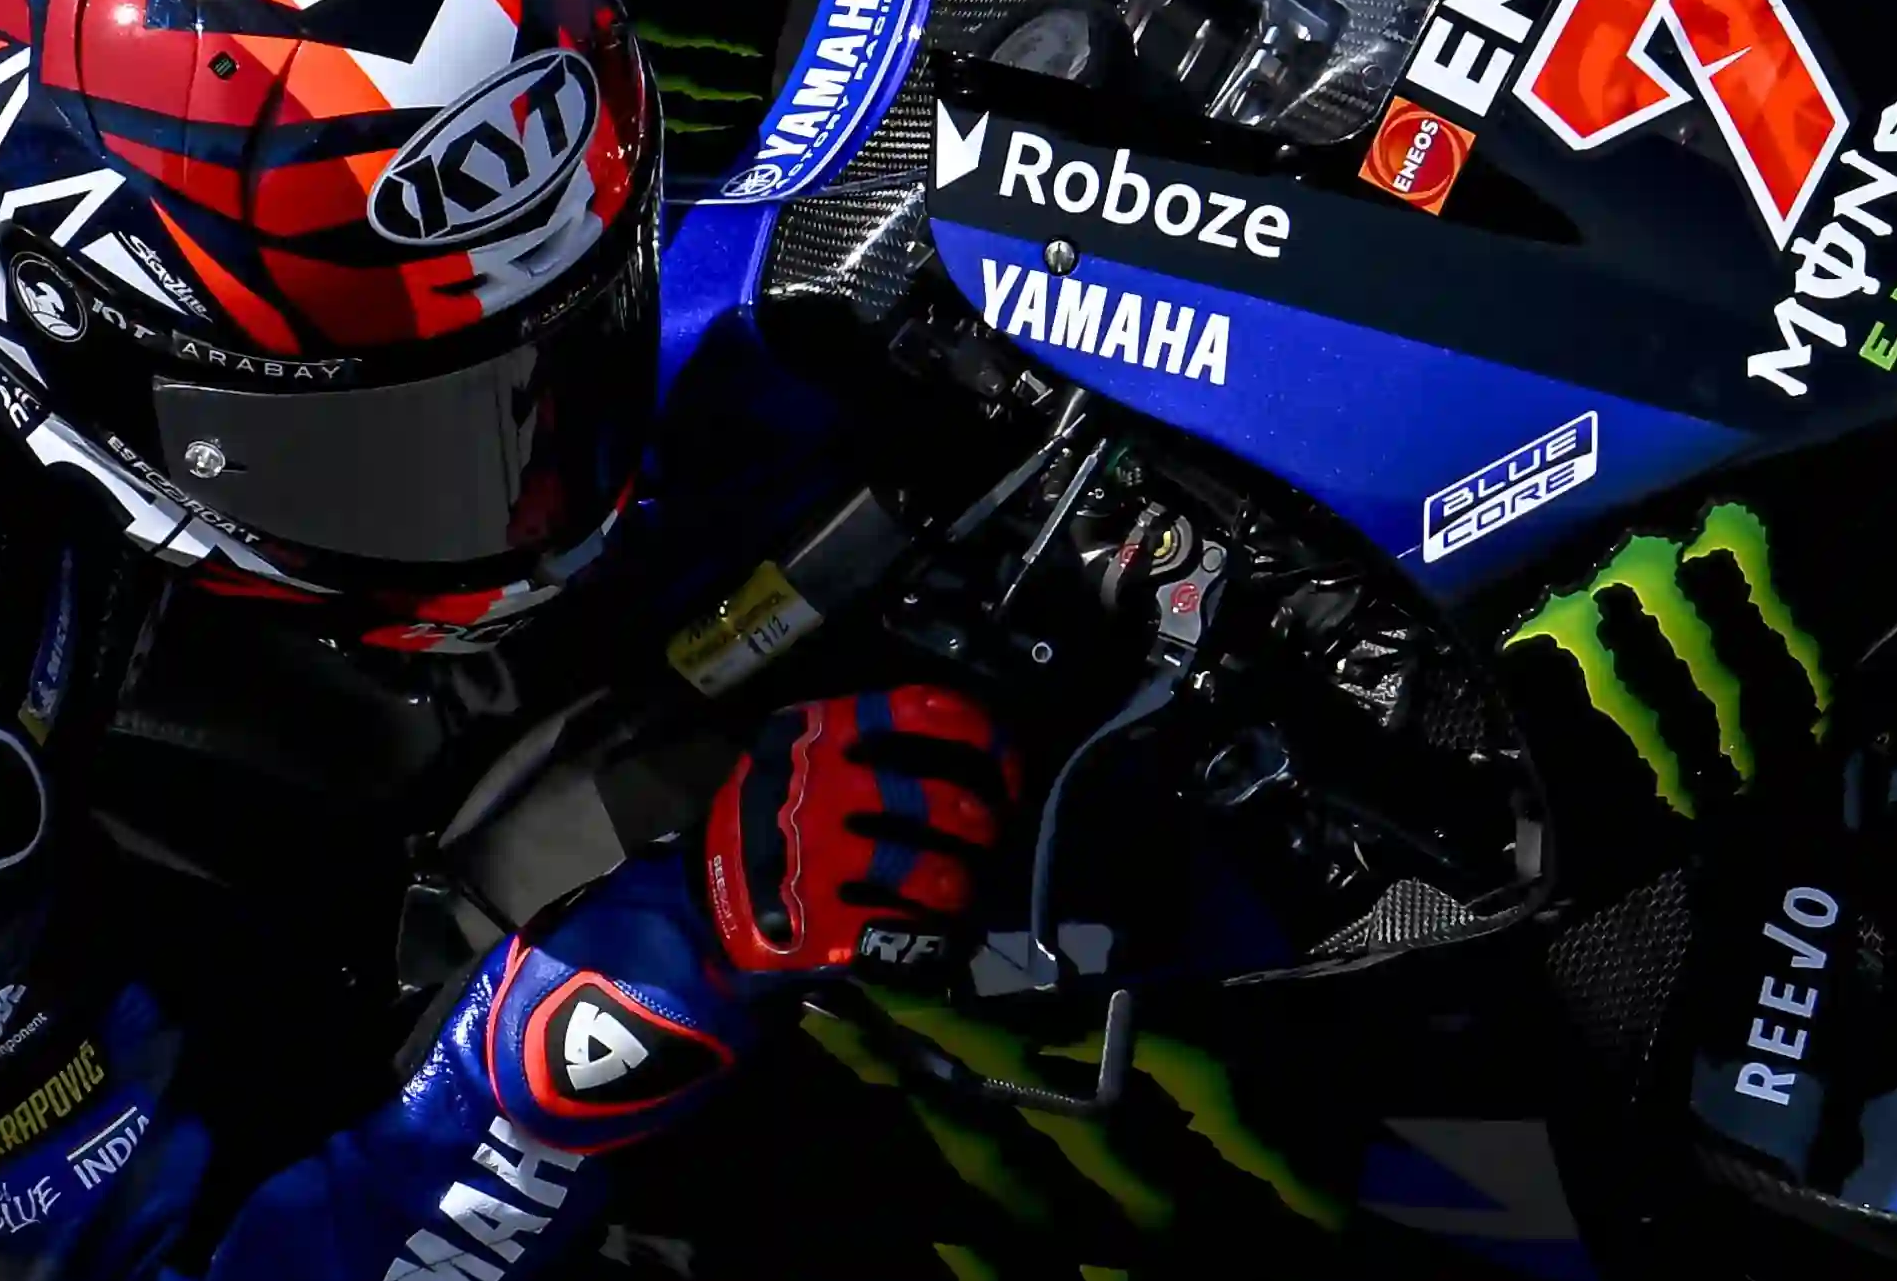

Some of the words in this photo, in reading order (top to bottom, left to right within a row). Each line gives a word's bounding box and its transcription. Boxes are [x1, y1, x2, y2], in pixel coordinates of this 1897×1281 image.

[408, 60, 572, 240] KYT
[999, 131, 1292, 260] Roboze
[1391, 118, 1440, 196] ENEOS
[181, 341, 341, 380] ARABAY
[981, 257, 1231, 387] YAMAHA
[1440, 426, 1579, 519] BLUE
[1440, 461, 1578, 551] CORE
